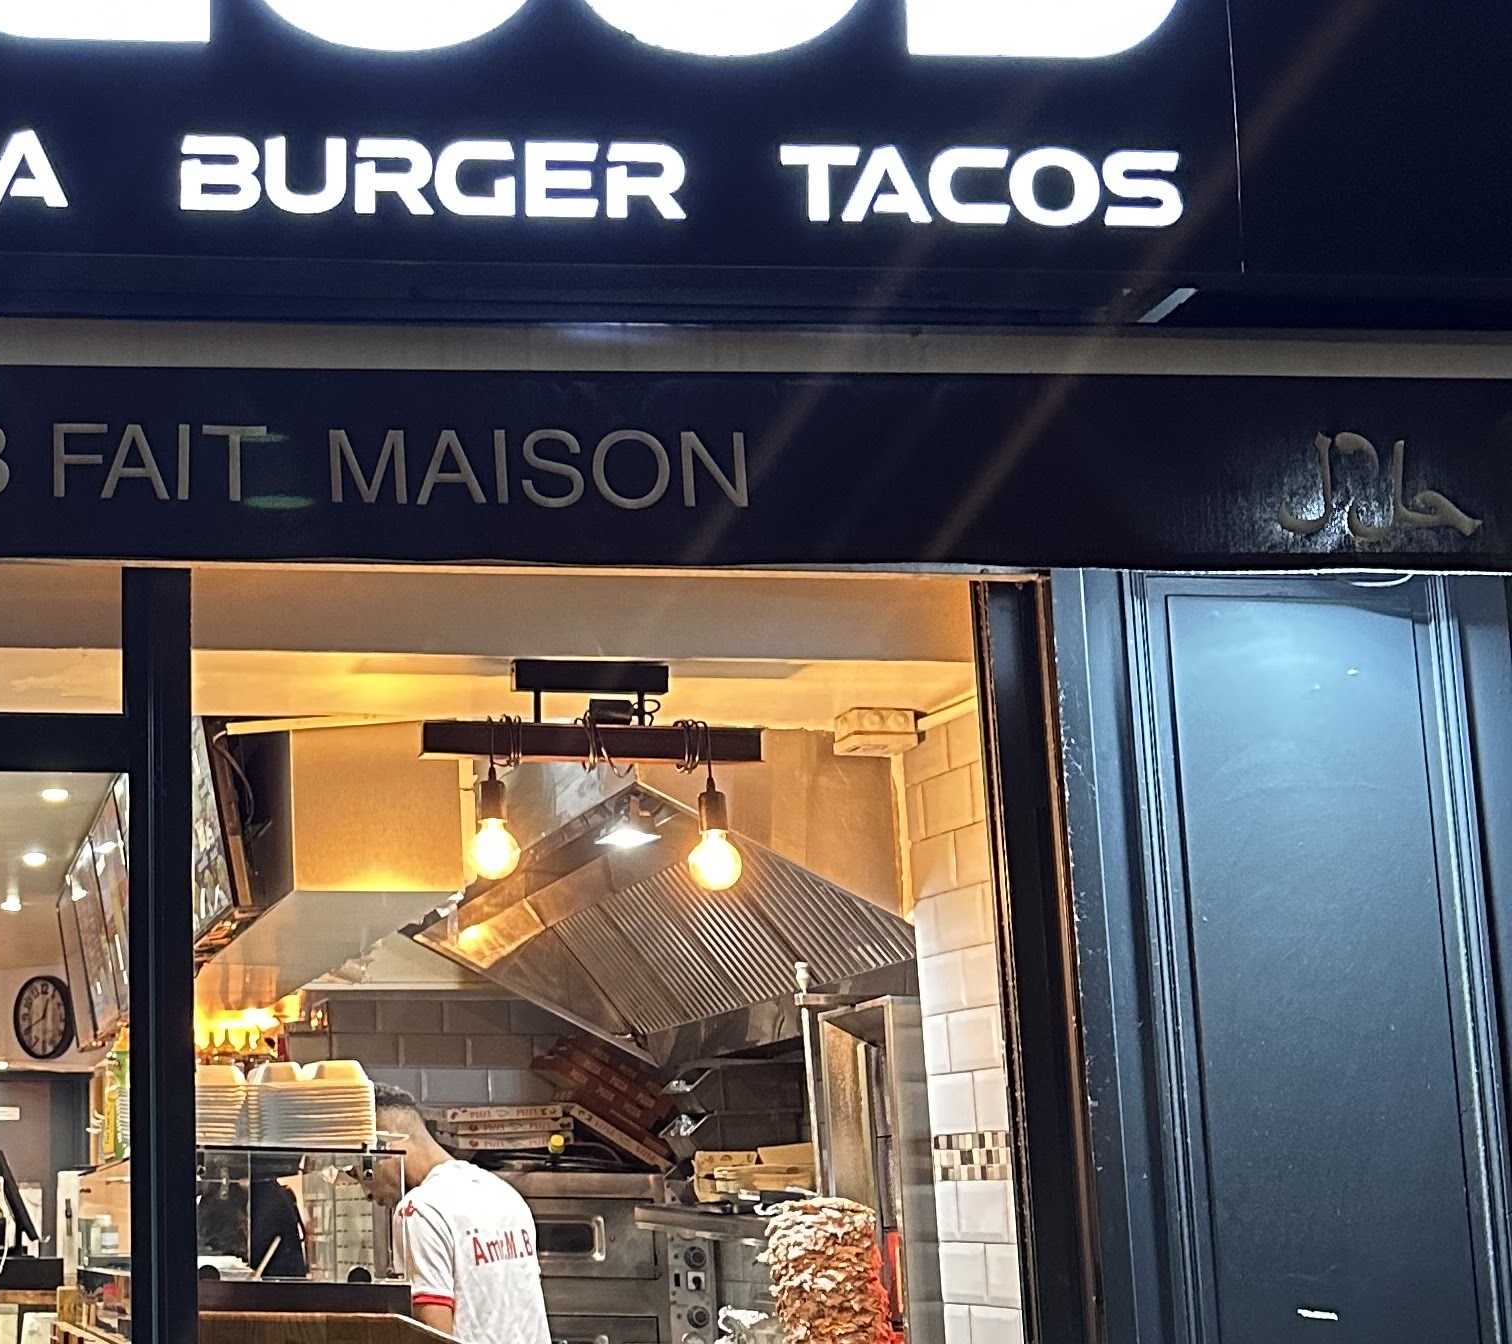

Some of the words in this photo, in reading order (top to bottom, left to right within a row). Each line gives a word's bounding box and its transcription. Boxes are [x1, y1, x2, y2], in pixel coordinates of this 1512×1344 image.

[178, 133, 688, 221] BURGER
[778, 143, 1185, 228] TACOS
[54, 422, 268, 502] FAIT
[328, 428, 749, 510] MAISON
